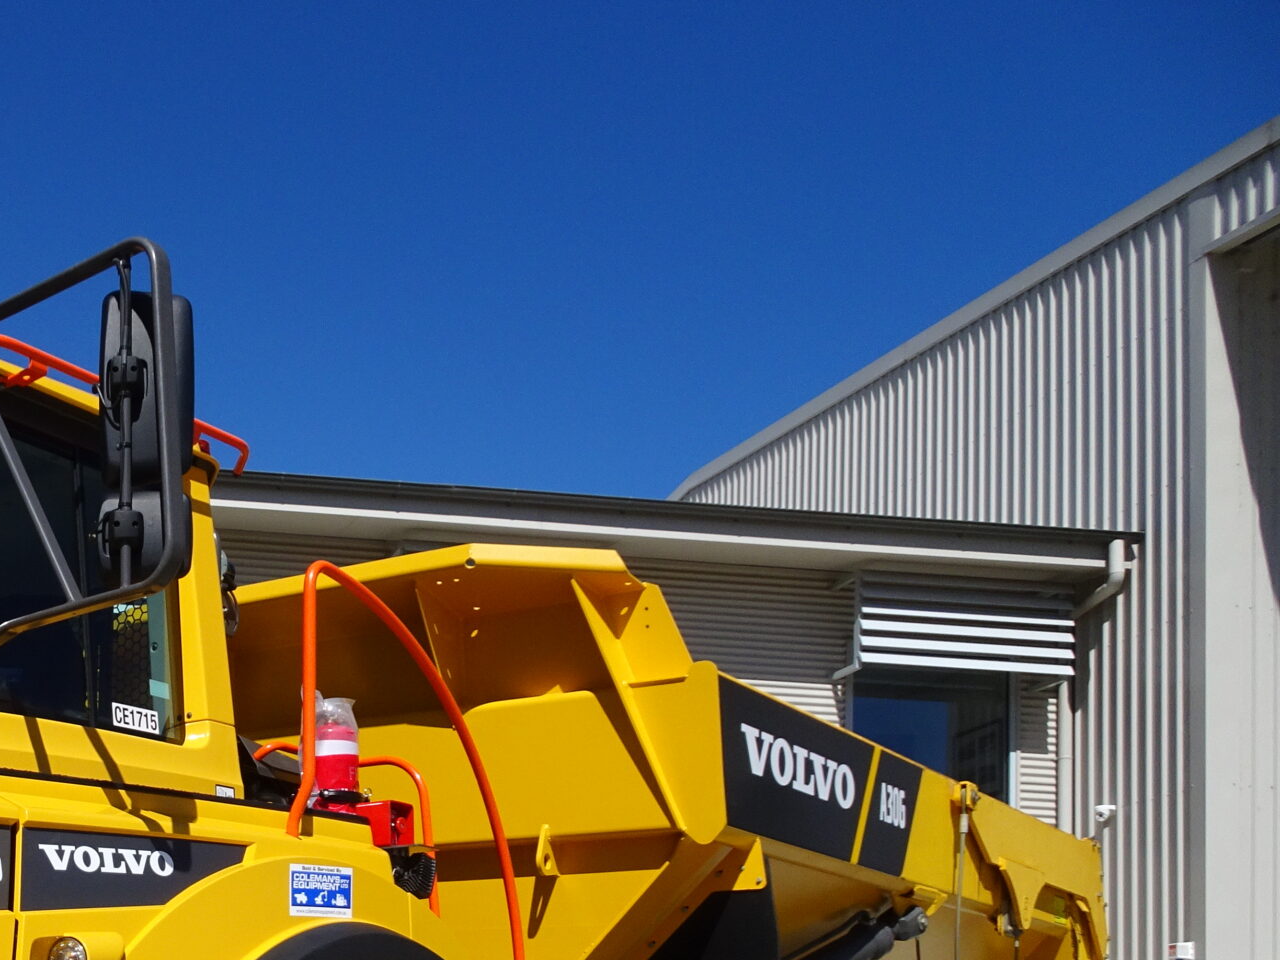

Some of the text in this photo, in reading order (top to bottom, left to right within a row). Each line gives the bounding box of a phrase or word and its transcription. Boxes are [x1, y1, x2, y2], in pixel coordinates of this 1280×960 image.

[114, 705, 158, 731] CE1715
[740, 722, 856, 810] VOLVO
[38, 843, 174, 877] VOLVO
[293, 873, 340, 883] COLEMAN'S
[293, 880, 340, 891] EQUIPMENT
